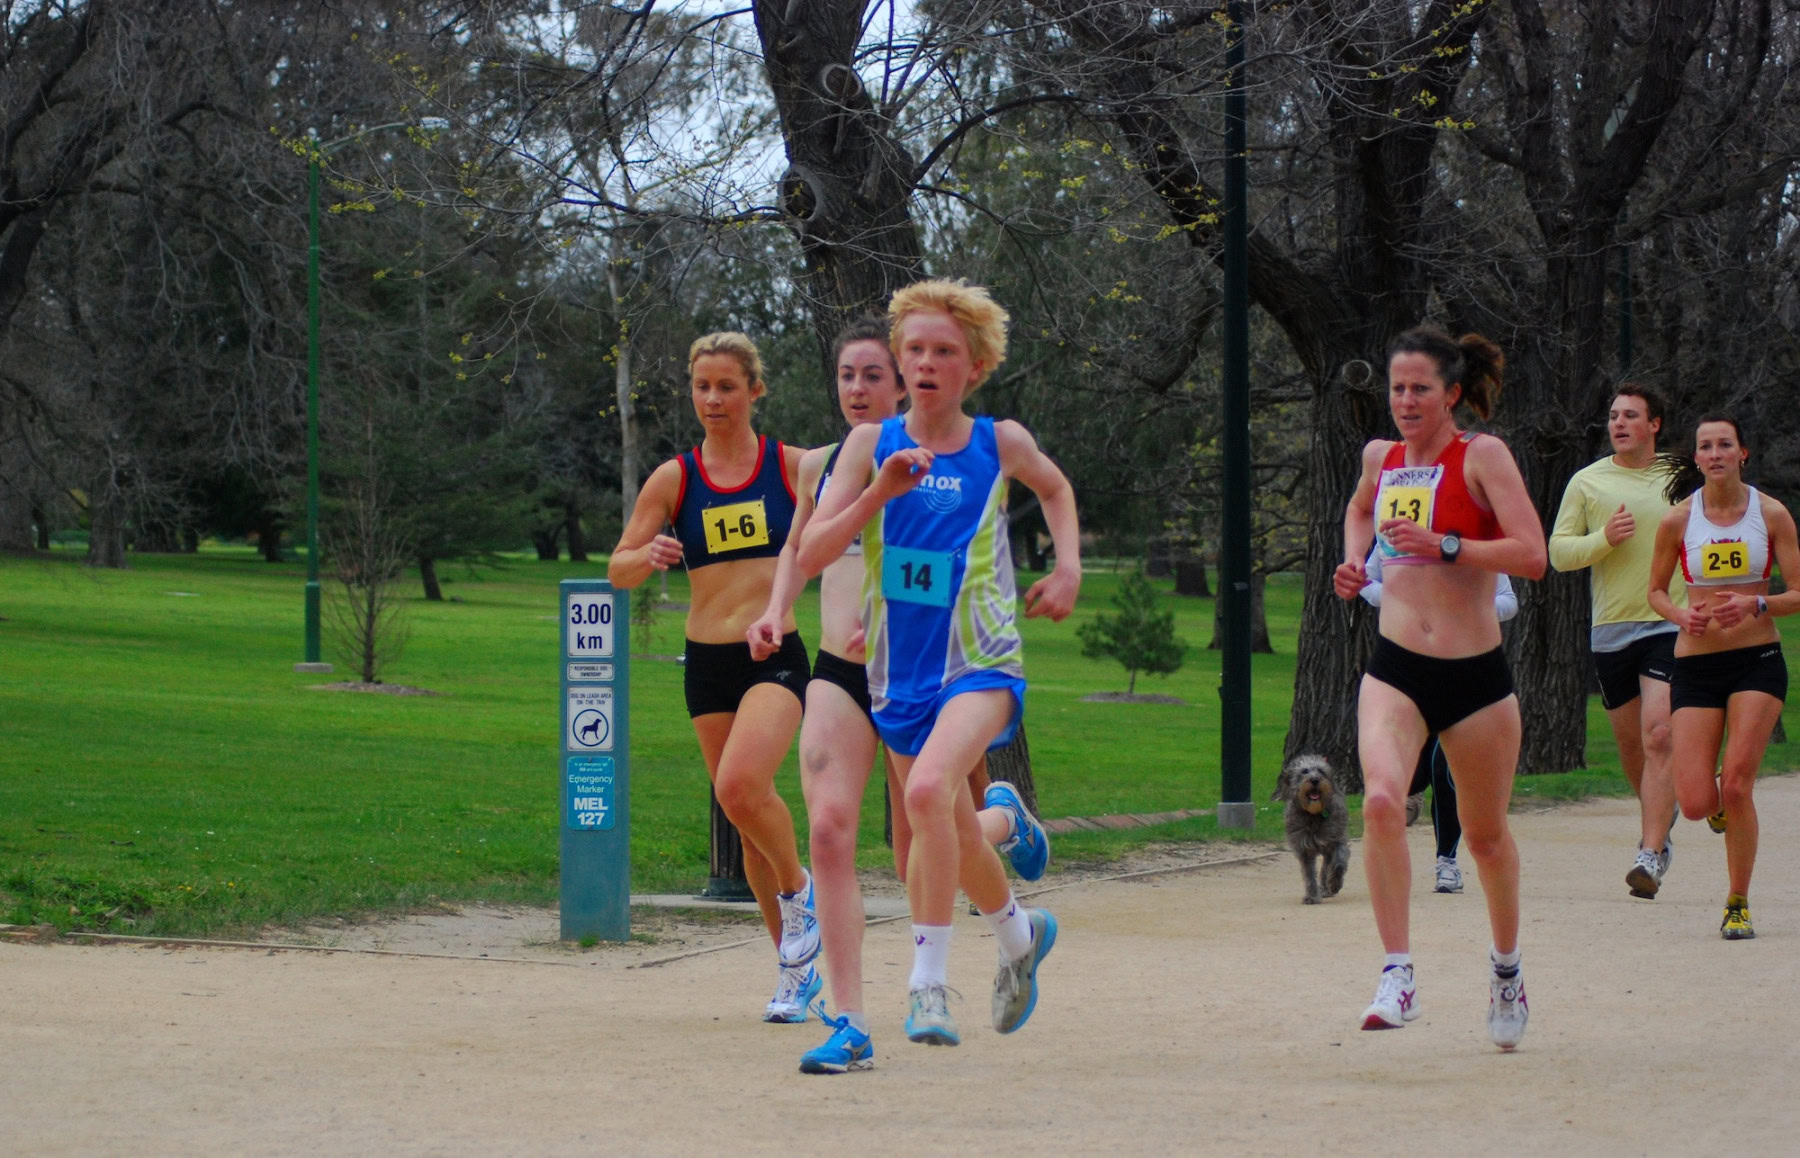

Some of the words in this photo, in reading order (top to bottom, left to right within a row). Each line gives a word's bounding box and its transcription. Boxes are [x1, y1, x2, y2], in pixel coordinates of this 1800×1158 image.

[920, 474, 962, 492] nox
[1389, 498, 1421, 523] 1-3
[714, 513, 756, 542] 1-6
[1708, 550, 1742, 571] 2-6
[900, 561, 933, 592] 14
[571, 603, 611, 625] 3.00
[577, 631, 603, 649] km
[568, 774, 613, 785] Emergency
[576, 785, 605, 793] Marker
[573, 797, 609, 811] MEL
[577, 812, 605, 825] 127
